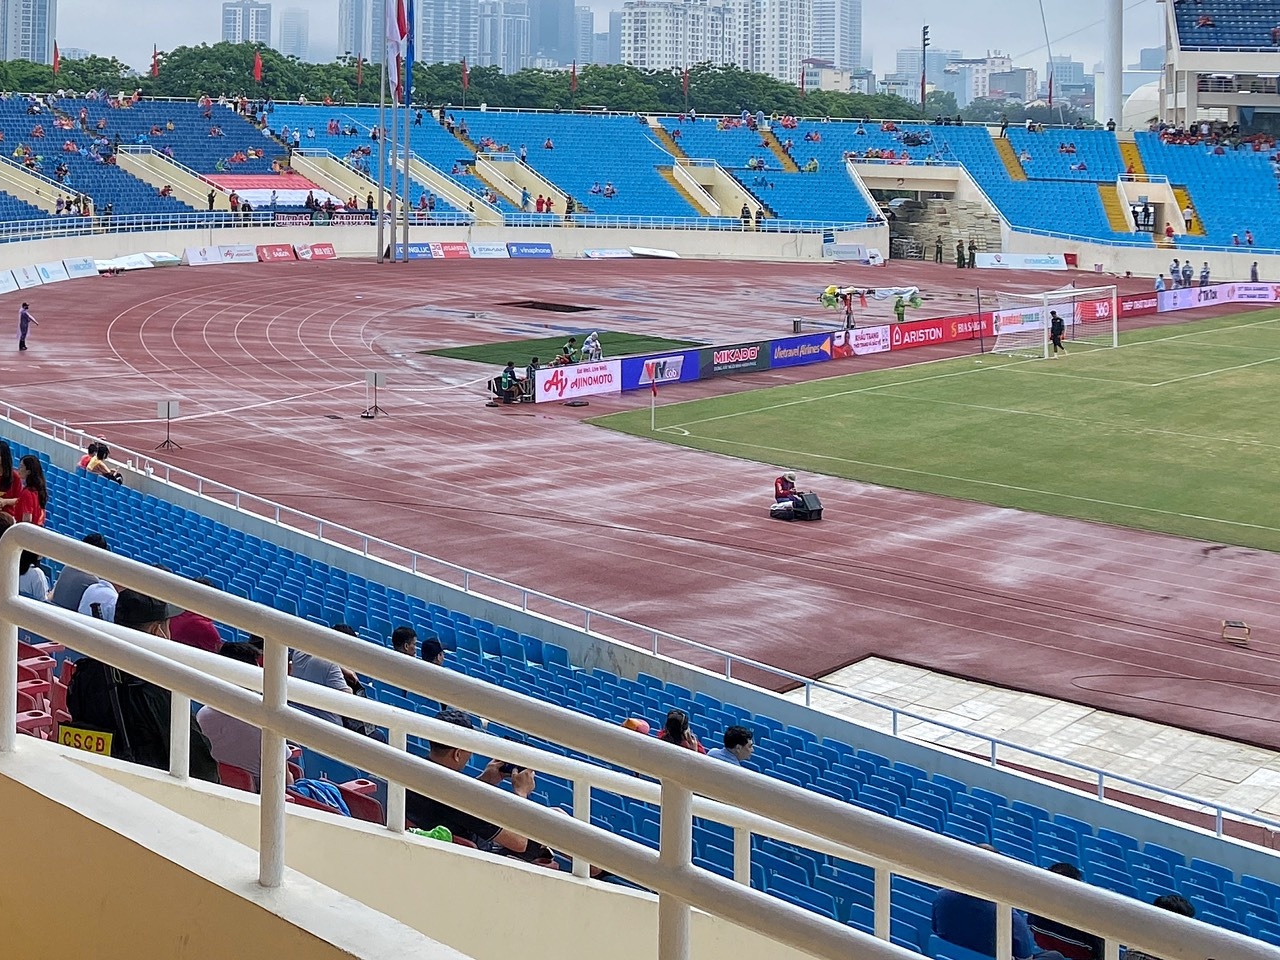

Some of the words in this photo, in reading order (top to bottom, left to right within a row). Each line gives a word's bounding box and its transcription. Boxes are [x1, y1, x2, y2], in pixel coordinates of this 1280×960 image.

[896, 177, 906, 189] 2
[519, 243, 551, 254] vinaphone
[903, 327, 943, 344] ARISTON
[713, 346, 758, 365] MIKADO
[773, 345, 800, 360] Vietravel
[799, 343, 821, 358] Airlines
[570, 373, 613, 389] AJINOMOTO
[62, 730, 106, 753] CSCĐ
[834, 895, 846, 906] 17
